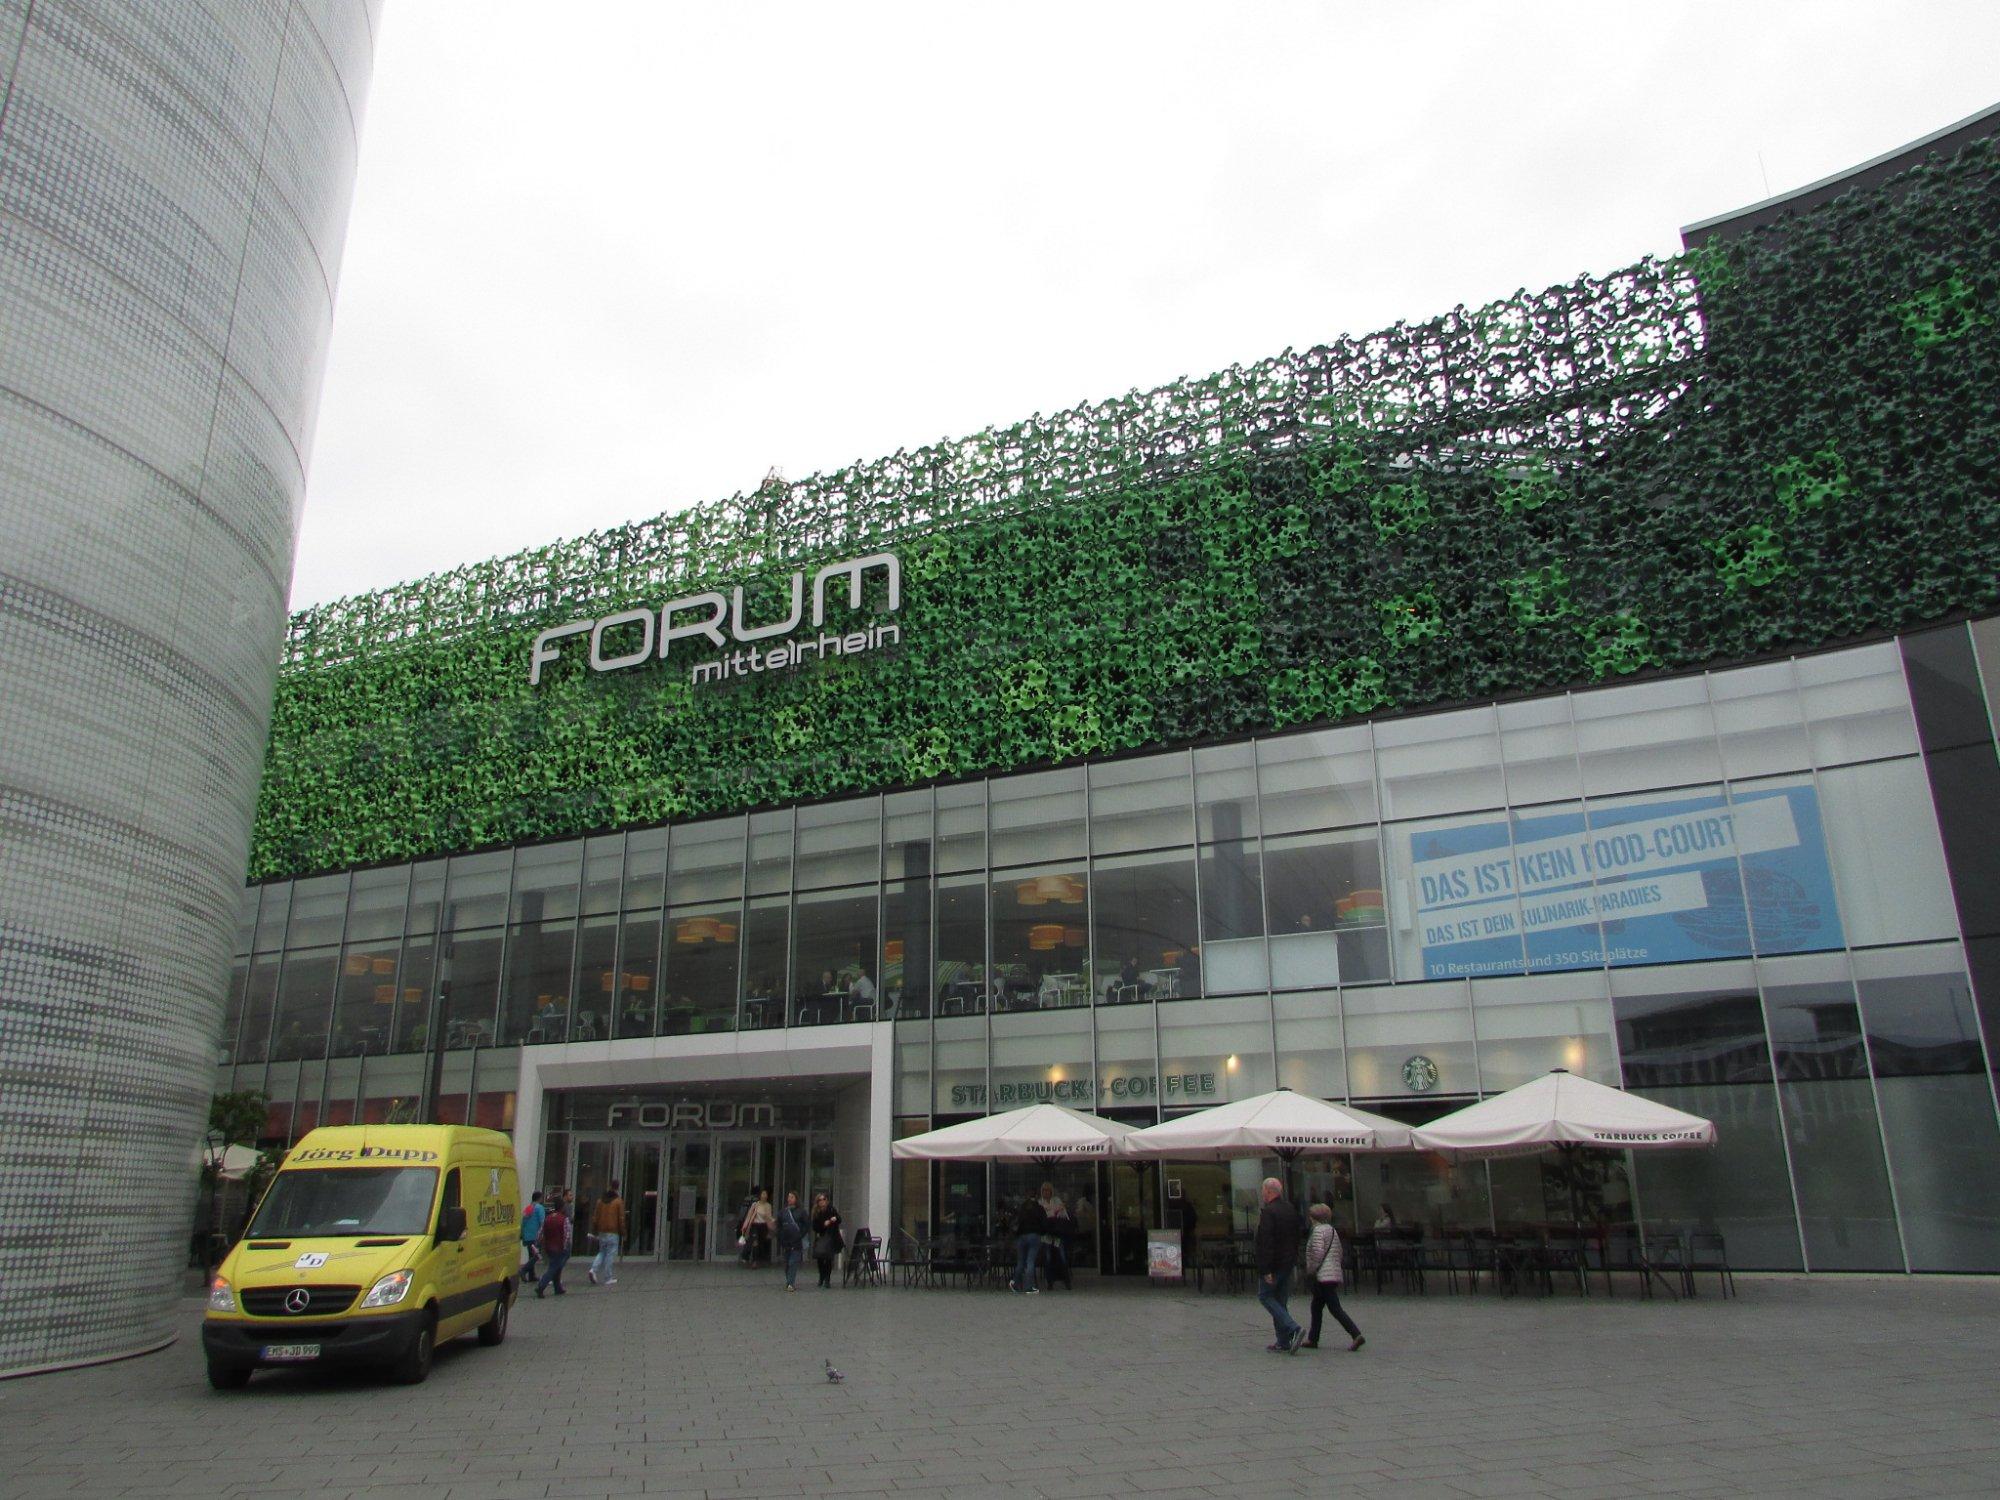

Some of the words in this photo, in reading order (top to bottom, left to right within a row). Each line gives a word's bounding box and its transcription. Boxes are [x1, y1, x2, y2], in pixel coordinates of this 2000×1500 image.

[530, 553, 900, 685] FORUM
[692, 621, 900, 685] mittelrhein
[1421, 868, 1470, 904] DAS
[1474, 860, 1511, 893] IST
[1519, 847, 1576, 885] KEIN
[1426, 924, 1455, 944] DAS
[1457, 919, 1479, 939] IST
[1483, 912, 1515, 935] DEIN
[1430, 963, 1446, 976] 10
[1448, 958, 1524, 974] Restaurants
[1526, 954, 1551, 968] und
[1554, 952, 1579, 965] 350
[951, 1079, 1104, 1105] STARBUCKS
[1110, 1073, 1217, 1098] COFFEE
[607, 1102, 775, 1127] FORUM
[1026, 1145, 1073, 1153] STARBUCKS
[1075, 1144, 1105, 1152] COFFEE
[1275, 1135, 1329, 1144] STARBUCKS
[1333, 1137, 1366, 1145] COFFEE
[1594, 1132, 1658, 1141] STARBUCKS
[1662, 1132, 1702, 1140] COFFEE
[292, 1147, 357, 1163] Jörg
[360, 1146, 438, 1162] Dupp
